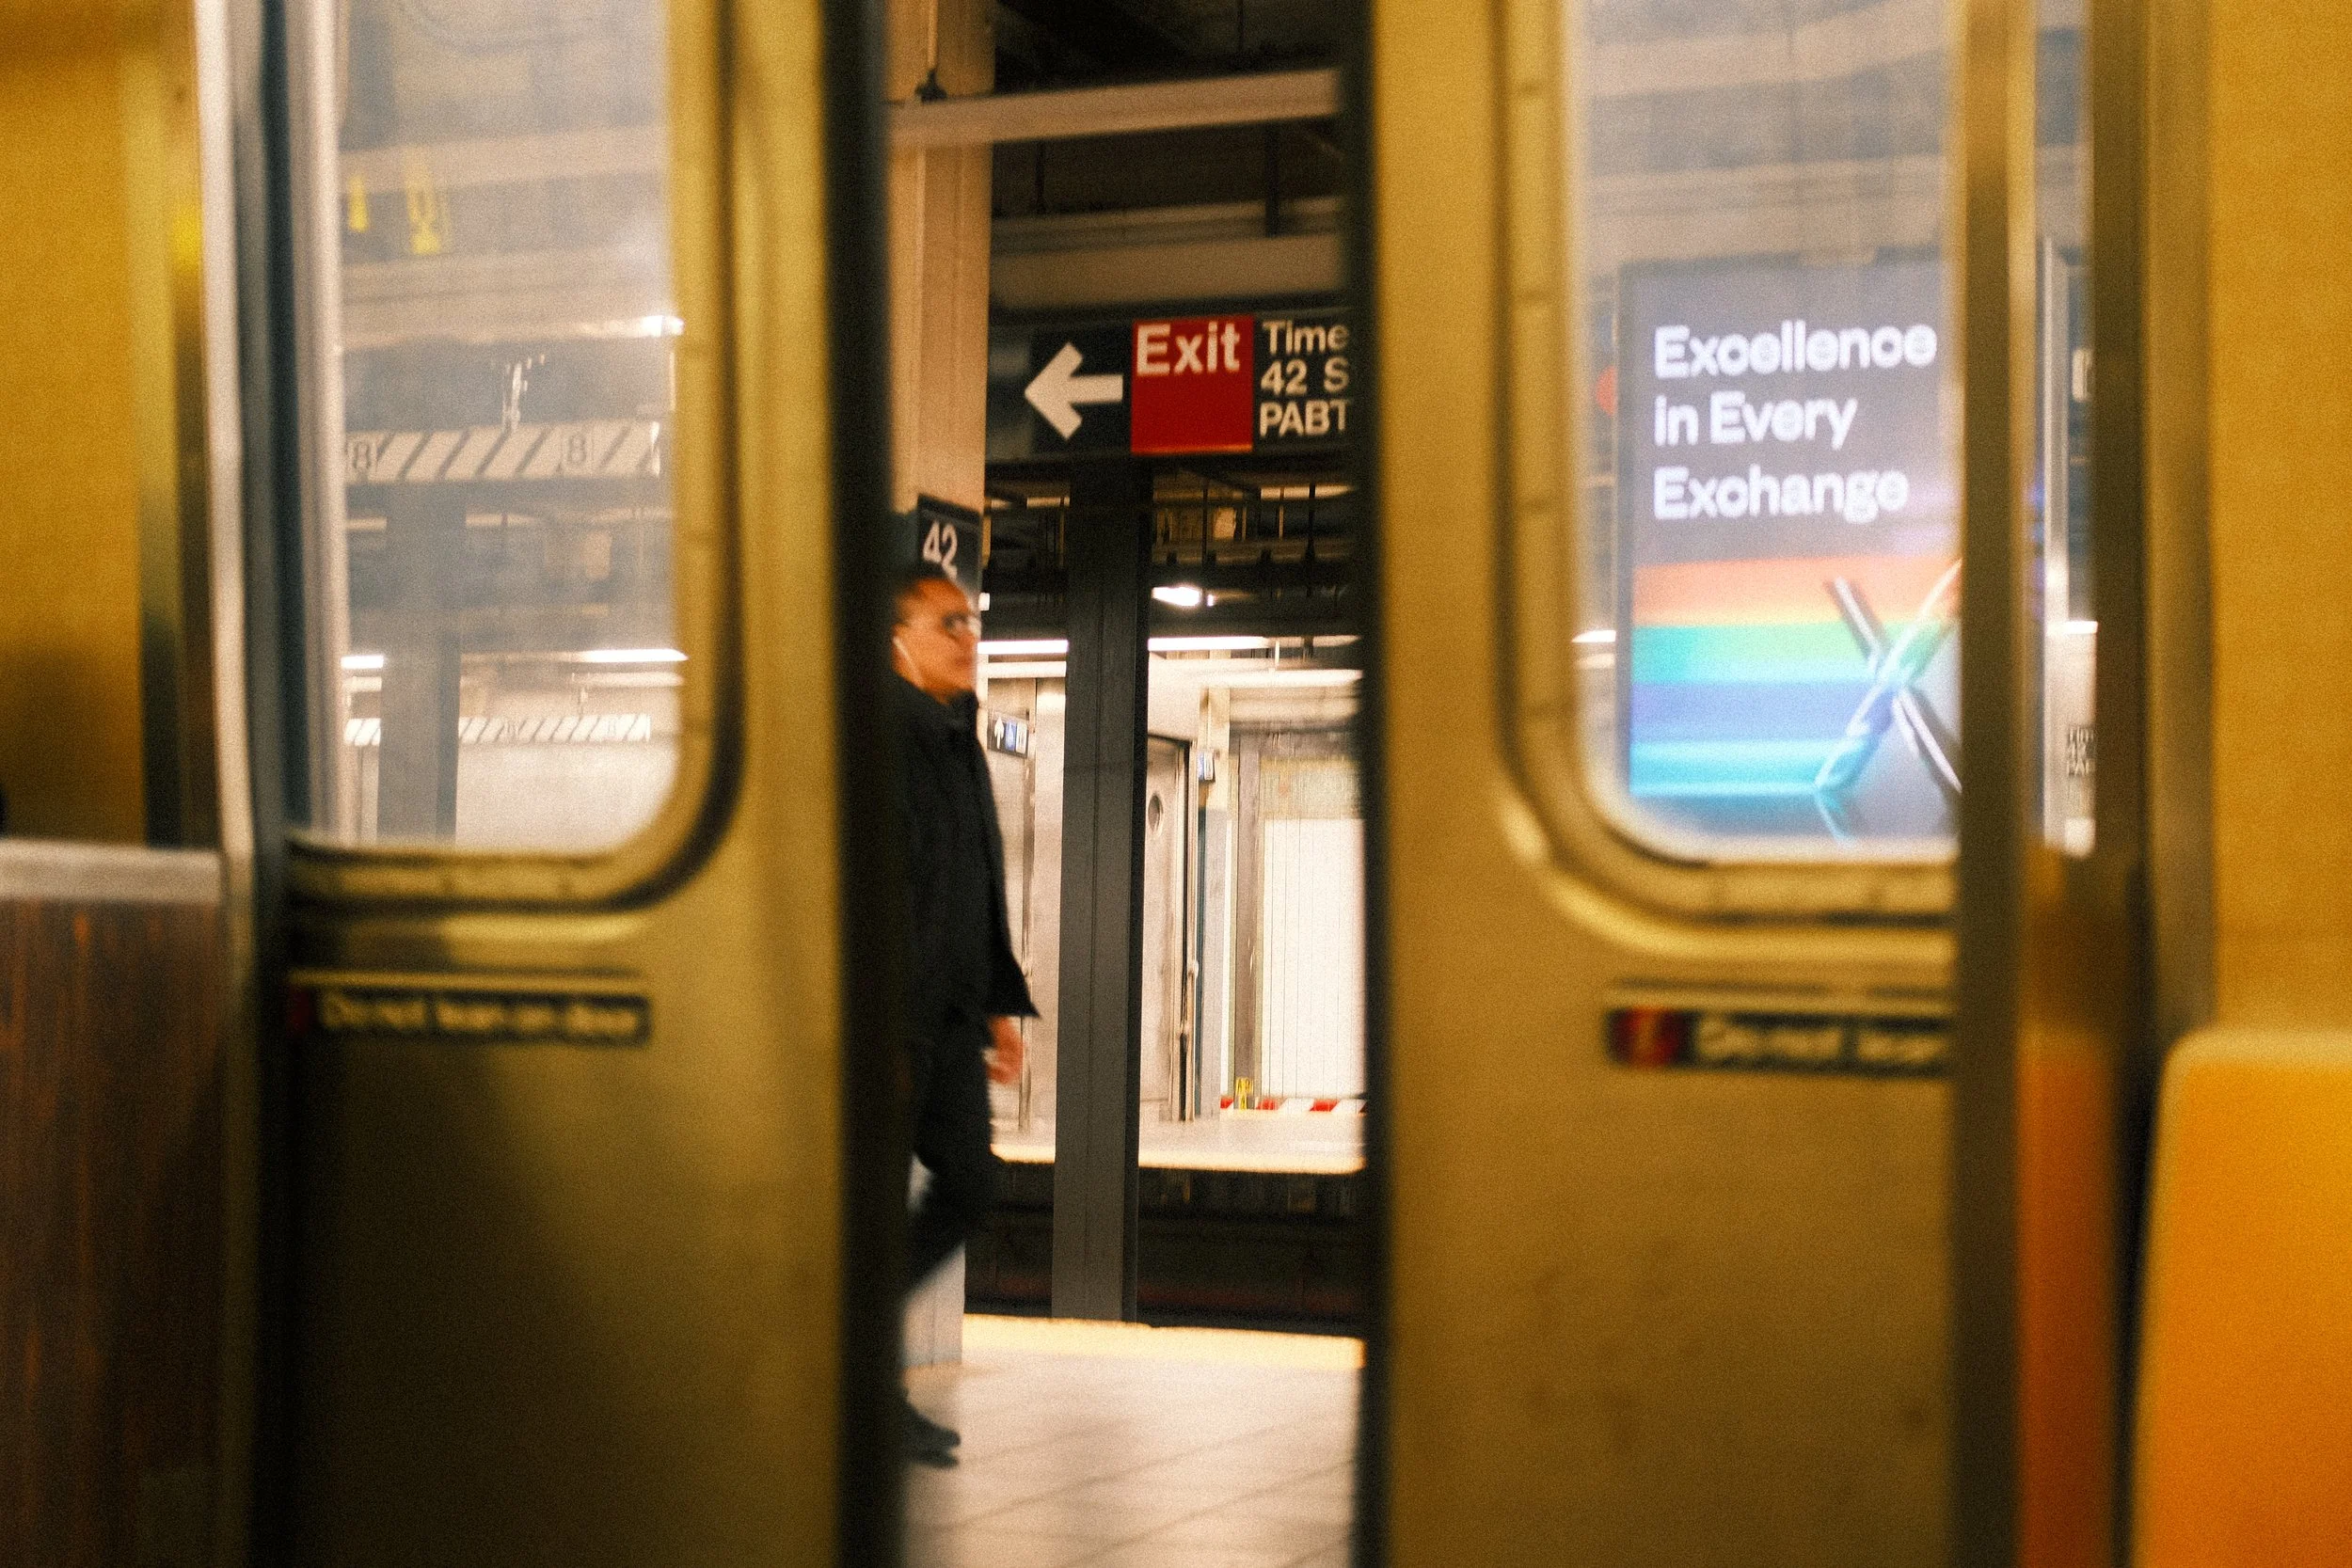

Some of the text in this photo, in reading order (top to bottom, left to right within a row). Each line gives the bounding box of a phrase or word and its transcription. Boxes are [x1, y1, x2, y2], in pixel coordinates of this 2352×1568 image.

[1136, 321, 1241, 376] Exit
[1263, 320, 1349, 356] Time
[1653, 320, 1938, 378] Excellence
[1260, 357, 1308, 396] 42
[1259, 398, 1350, 439] PABT
[1654, 390, 1859, 451] in Every
[1653, 464, 1910, 525] Exchange
[923, 519, 958, 580] 42
